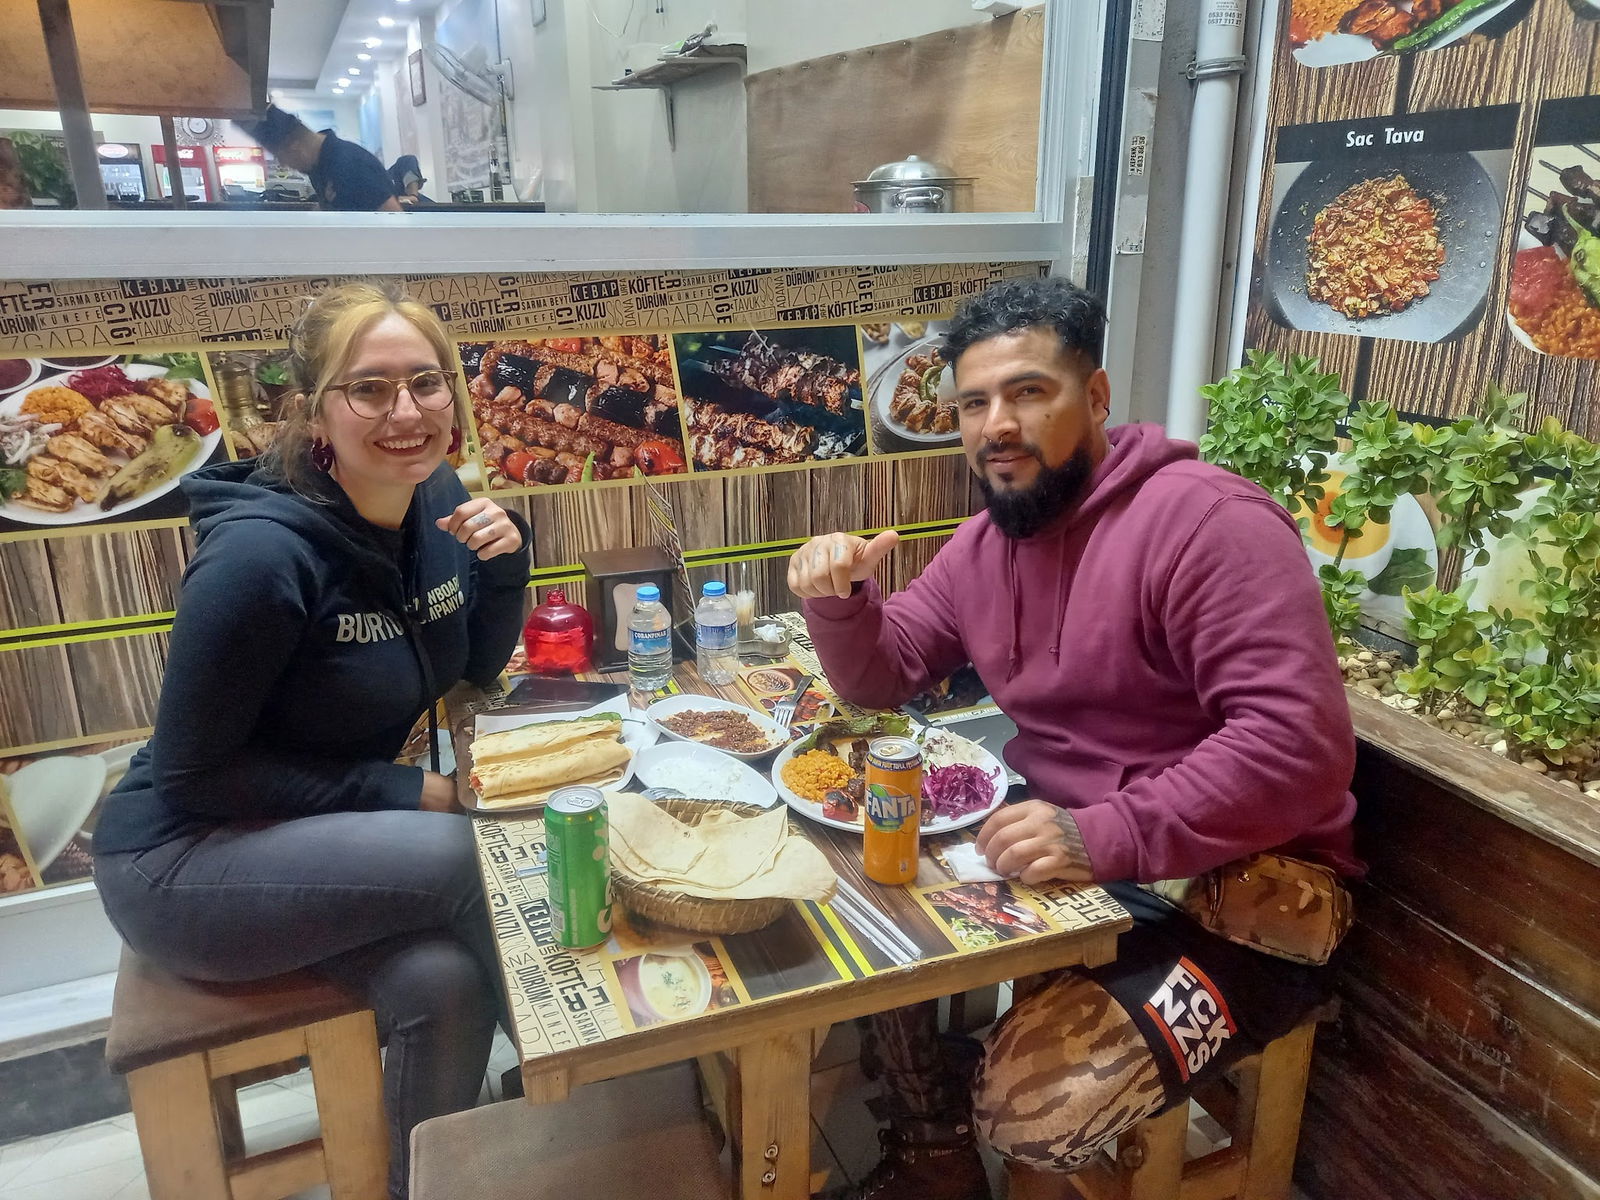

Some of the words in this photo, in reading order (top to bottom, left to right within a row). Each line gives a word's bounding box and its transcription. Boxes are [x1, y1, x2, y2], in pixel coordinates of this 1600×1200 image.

[1345, 130, 1375, 148] Sac
[1384, 127, 1425, 145] Tava
[123, 279, 185, 298] KEBAP
[628, 274, 666, 295] KÖFTE
[682, 276, 706, 287] SARMA
[732, 280, 759, 298] KUZU
[786, 270, 816, 288] DÜRÜM
[873, 273, 900, 288] TAVUK
[959, 278, 991, 296] KÖFTE
[56, 294, 92, 308] SARMA
[208, 287, 252, 307] DÜRÜM
[571, 282, 618, 302] KEBAP
[635, 292, 668, 311] DÜRÜM
[774, 274, 786, 309] ADANA
[786, 278, 859, 308] IZGARA
[914, 284, 952, 303] KEBAP
[130, 297, 171, 320] KUZU
[192, 294, 212, 334] ADANA
[460, 298, 504, 320] KÖFTE
[521, 298, 548, 311] SARMA
[576, 302, 607, 322] KUZU
[733, 298, 759, 312] TAVUK
[827, 300, 860, 319] KÖFTE
[873, 300, 895, 311] SARMA
[0, 314, 38, 335] ÜRÜM
[136, 317, 176, 338] TAVUK
[866, 788, 917, 819] FANTA
[477, 822, 512, 852] KÖFTE
[496, 863, 518, 885] SARMA
[519, 899, 555, 945] KEBAP
[543, 950, 589, 996] KÖFTE
[515, 964, 554, 1004] DÜRÜM
[1165, 963, 1231, 1057] FCK
[572, 1011, 601, 1043] SARMA
[1148, 982, 1211, 1074] NZS
